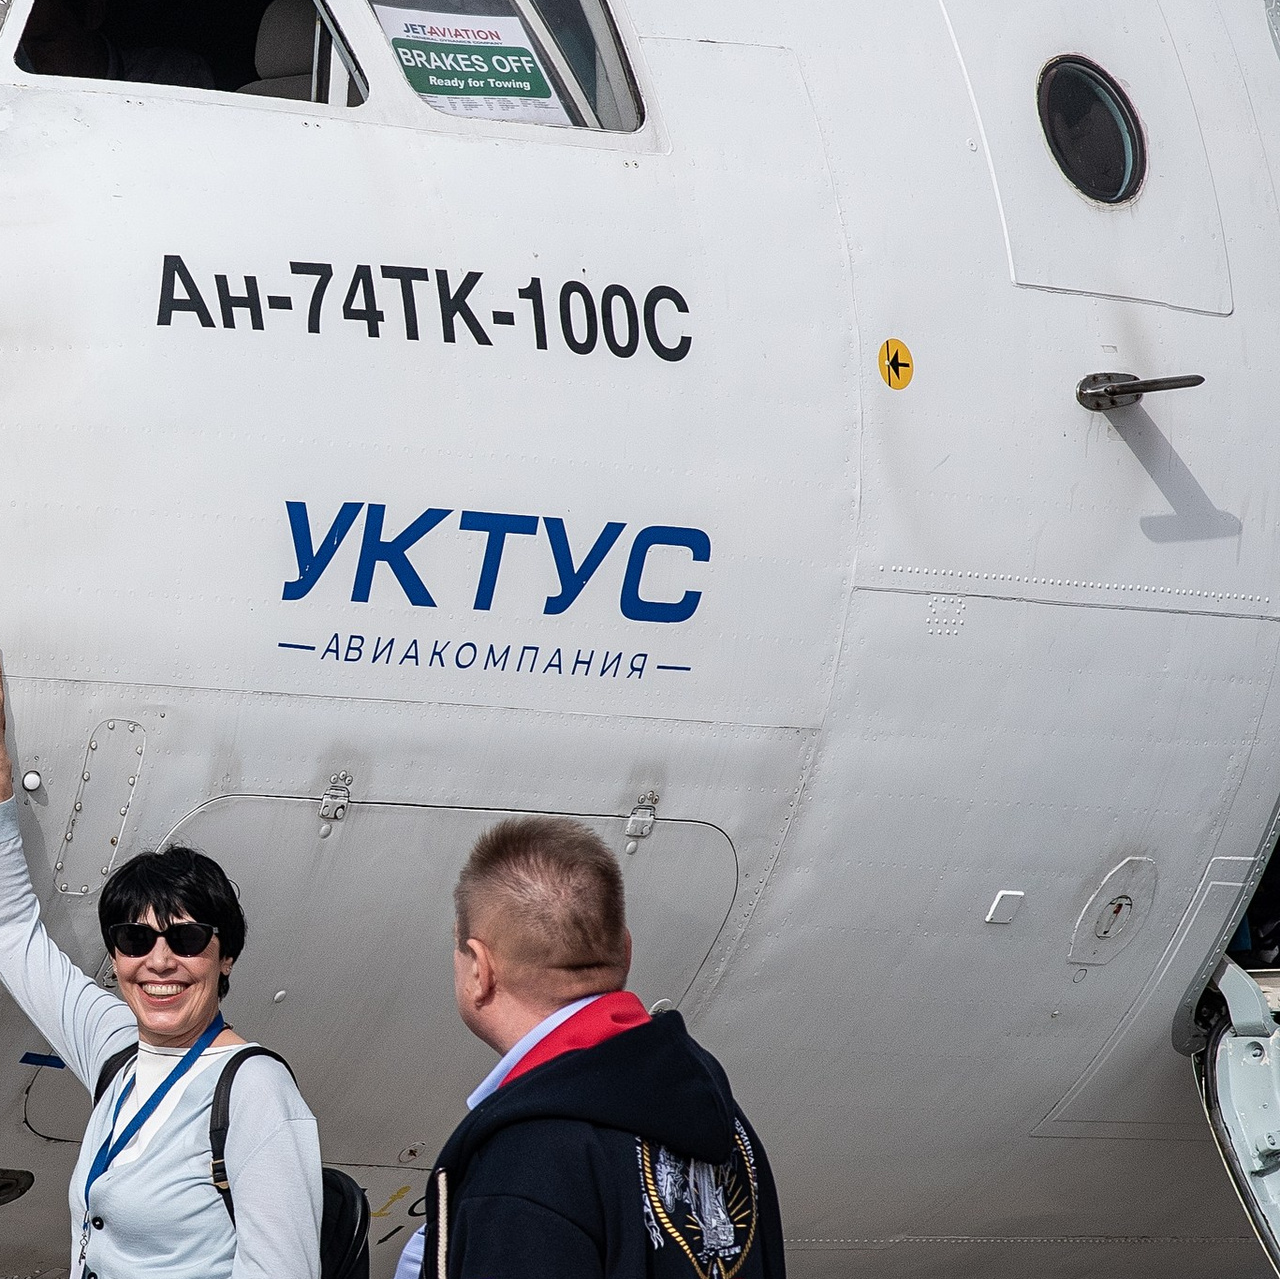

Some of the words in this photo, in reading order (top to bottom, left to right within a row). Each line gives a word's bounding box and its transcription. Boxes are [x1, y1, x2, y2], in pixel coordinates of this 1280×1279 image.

[397, 47, 489, 72] BRAKES
[491, 55, 535, 73] OFF
[428, 75, 465, 89] Ready
[467, 77, 485, 88] for
[487, 78, 531, 91] Towing
[156, 254, 694, 363] Ан-74ТК-100С
[281, 500, 713, 625] УКТУС
[321, 632, 649, 680] АВИАКОМПАНИЯ
